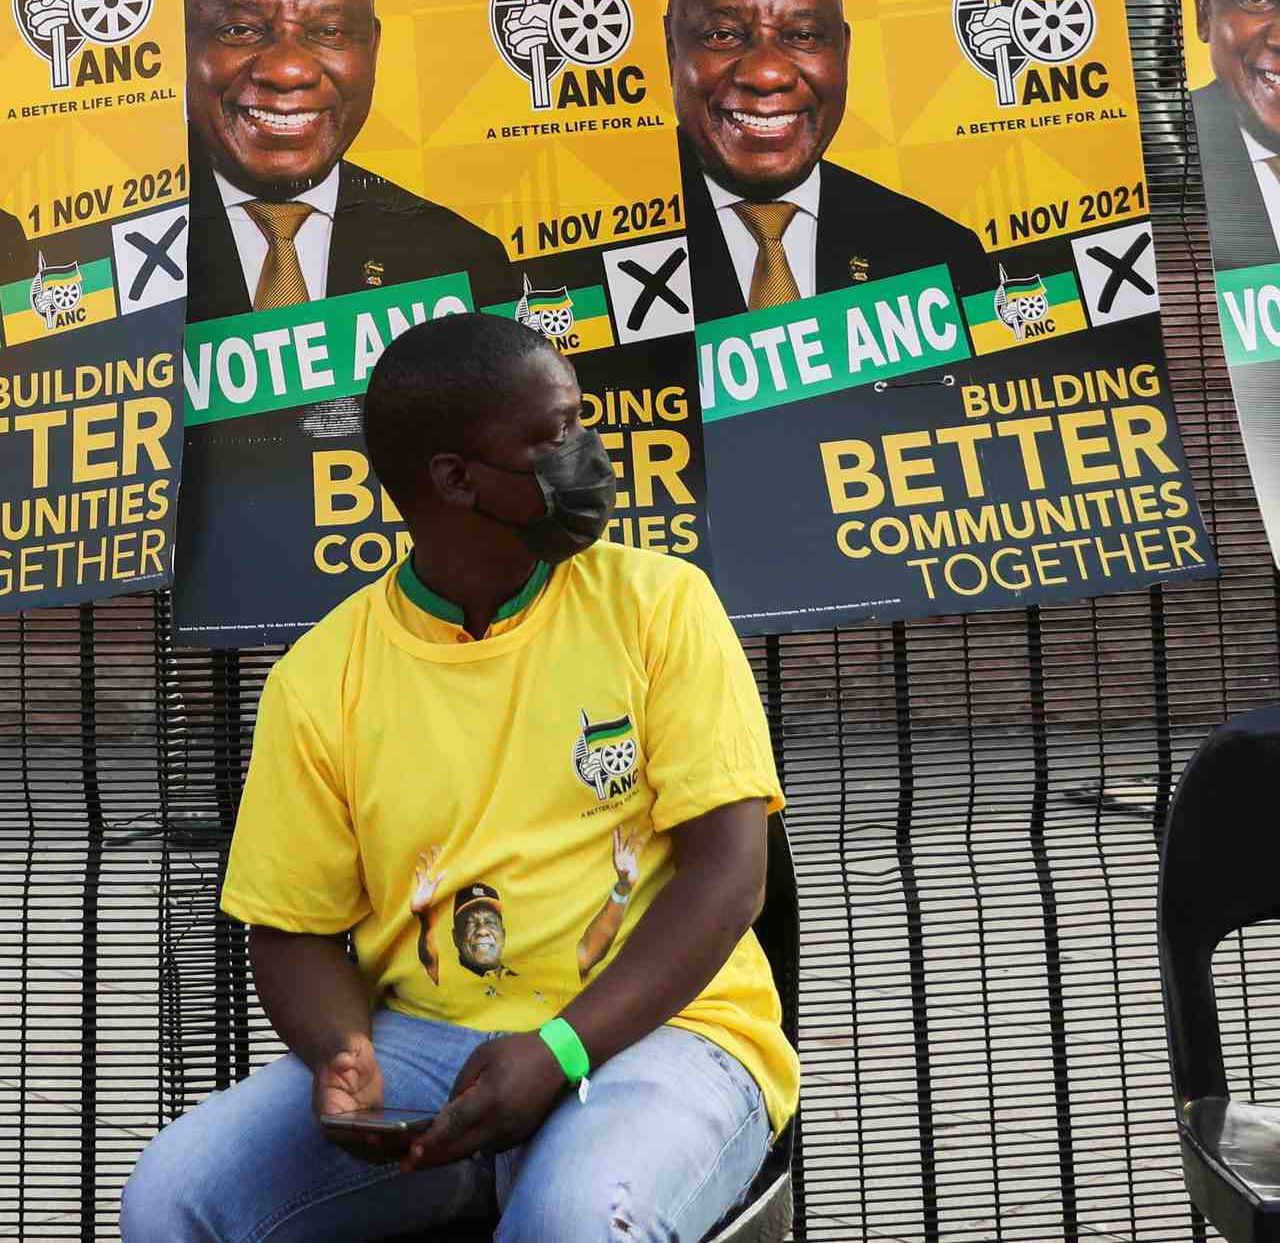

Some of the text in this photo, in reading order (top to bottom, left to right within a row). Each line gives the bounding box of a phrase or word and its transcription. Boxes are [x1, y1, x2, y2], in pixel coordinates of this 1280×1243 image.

[76, 41, 161, 87] ANC
[557, 65, 646, 109] ANC
[1022, 62, 1109, 106] ANC
[8, 89, 176, 119] A BETTER LIFE FOR ALL
[487, 115, 664, 139] A BETTER LIFE FOR ALL
[956, 108, 1127, 136] A BETTER LIFE FOR ALL
[28, 165, 186, 233] 1 NOV 2021
[985, 182, 1145, 245] 1 NOV 2021
[511, 194, 681, 254] 1 NOV 2021
[55, 308, 86, 329] ANC
[846, 287, 958, 374] ANC
[1024, 319, 1056, 339] ANC
[961, 364, 1160, 418] BUILDING
[819, 404, 1180, 514] BETTER
[836, 482, 1189, 558] COMMUNITIES
[907, 524, 1206, 599] TOGETHER
[610, 768, 638, 797] ANC
